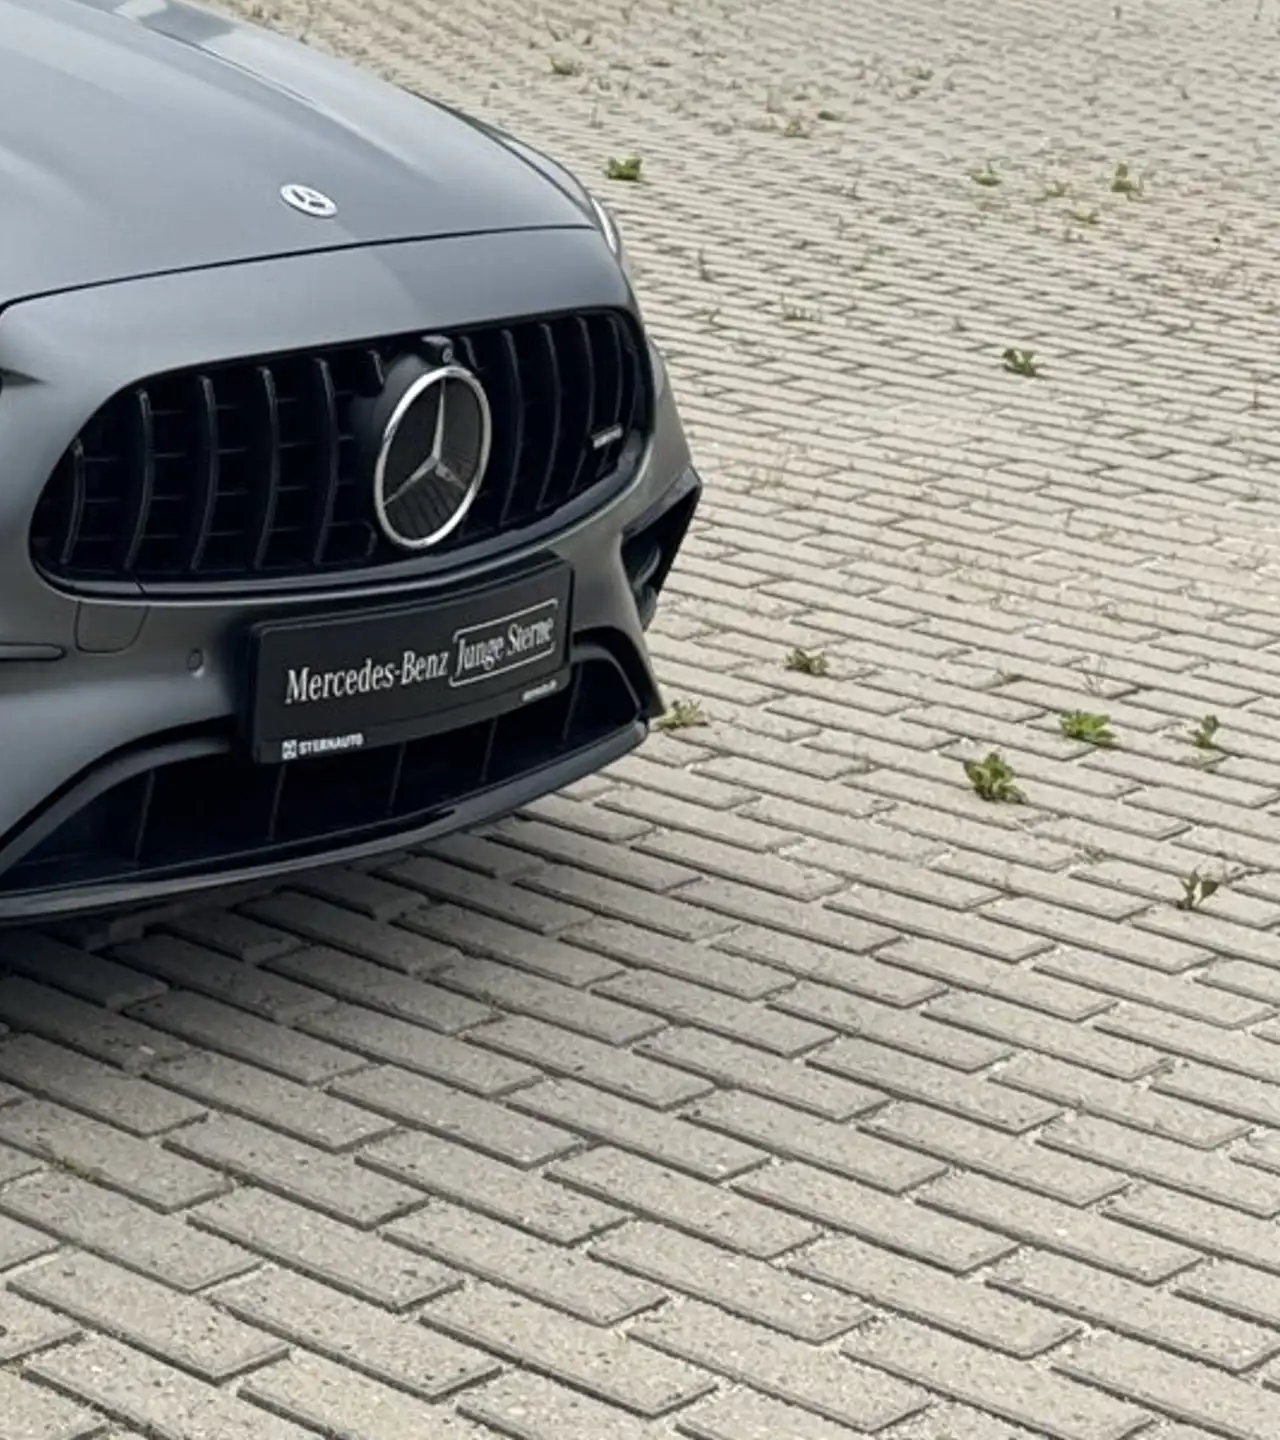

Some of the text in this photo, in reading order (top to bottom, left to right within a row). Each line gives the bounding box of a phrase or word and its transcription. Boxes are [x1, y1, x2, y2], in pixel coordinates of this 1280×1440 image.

[284, 617, 554, 705] Mercedes-Benz Junge Sterne
[299, 732, 364, 756] STERNAUTO
